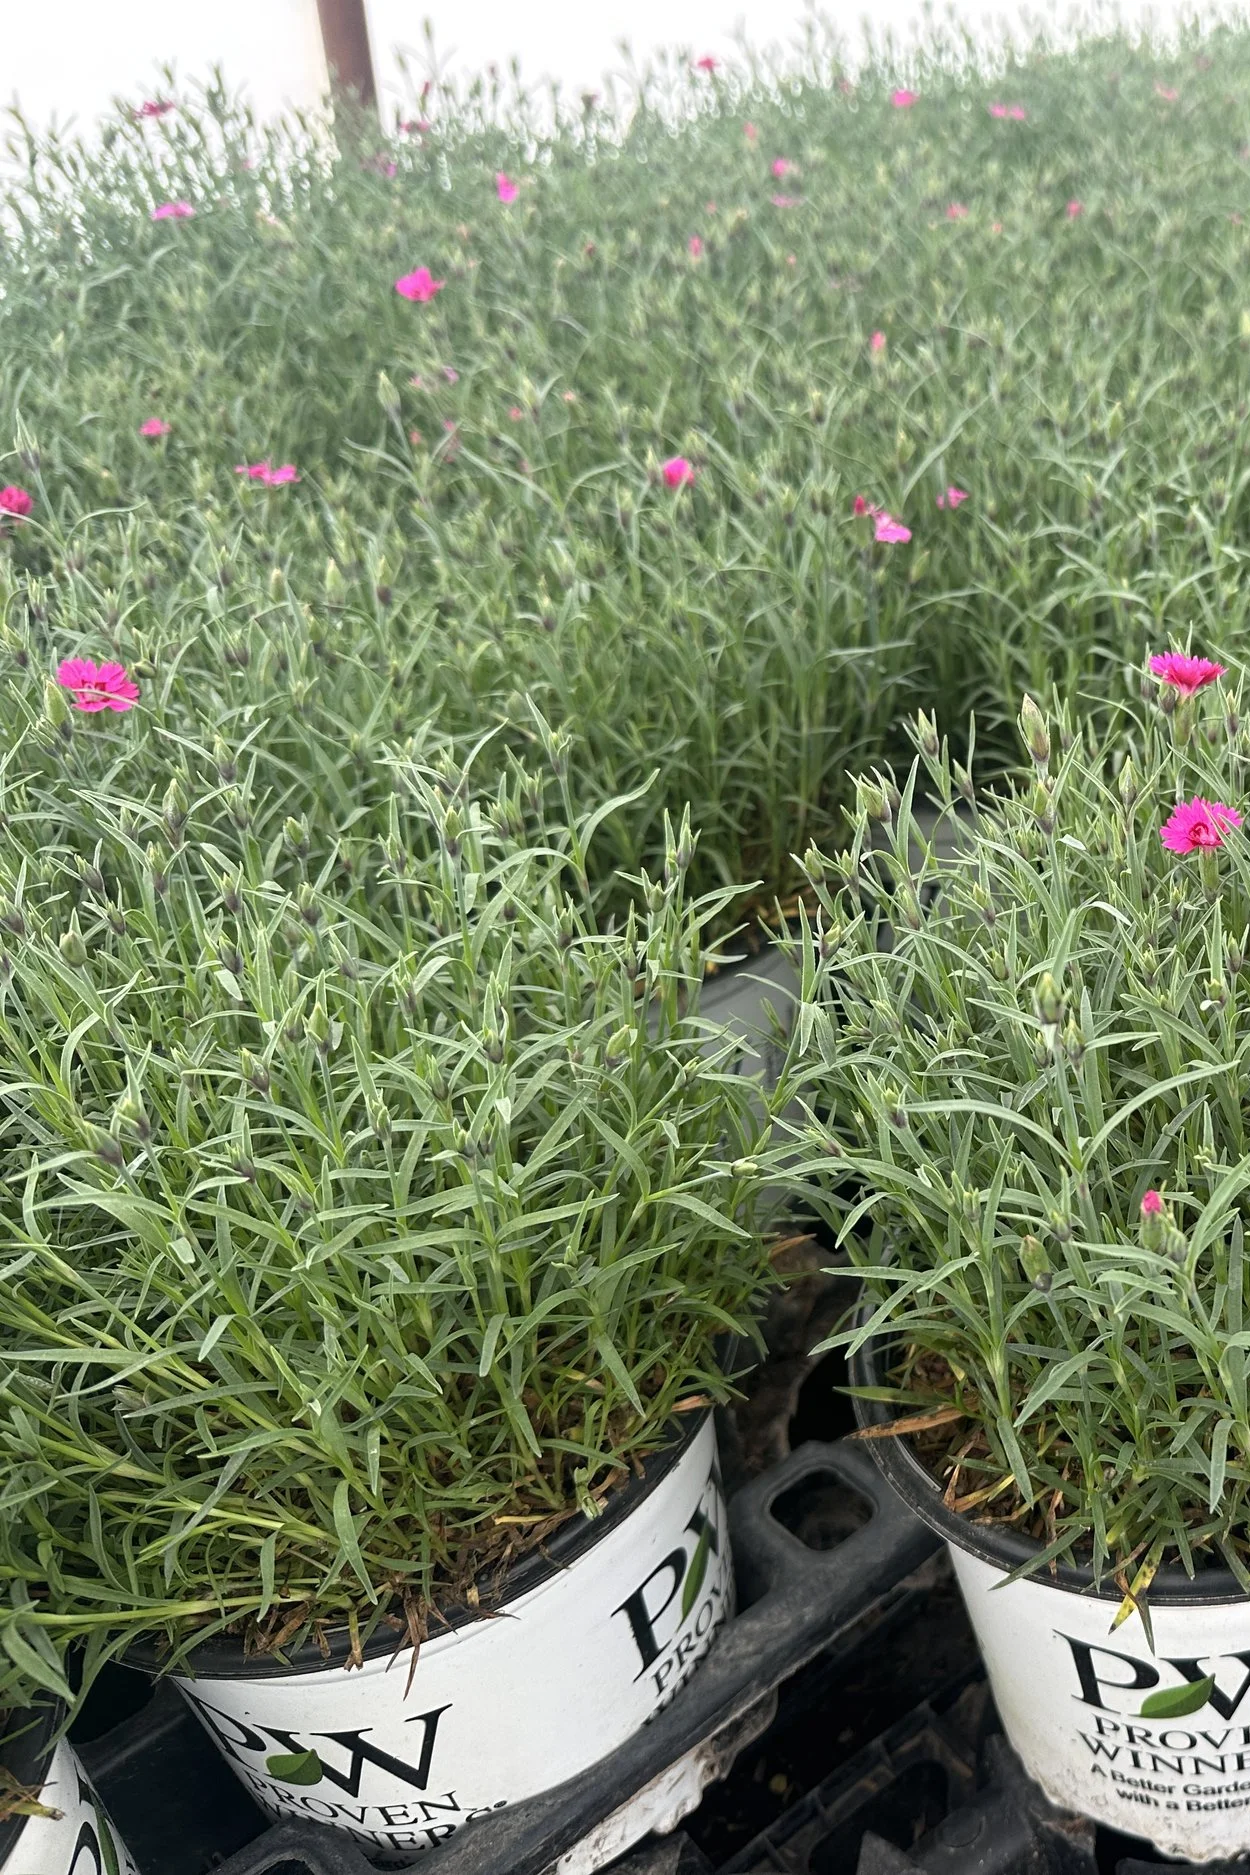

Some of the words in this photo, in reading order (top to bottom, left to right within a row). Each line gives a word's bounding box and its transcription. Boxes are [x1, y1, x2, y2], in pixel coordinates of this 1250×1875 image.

[171, 1677, 453, 1798] PW
[242, 1770, 456, 1826] PROVEN
[1091, 1763, 1107, 1777] A
[1111, 1771, 1175, 1796] Better
[1116, 1788, 1159, 1807] with
[1166, 1800, 1179, 1810] a
[1187, 1796, 1250, 1811] Better
